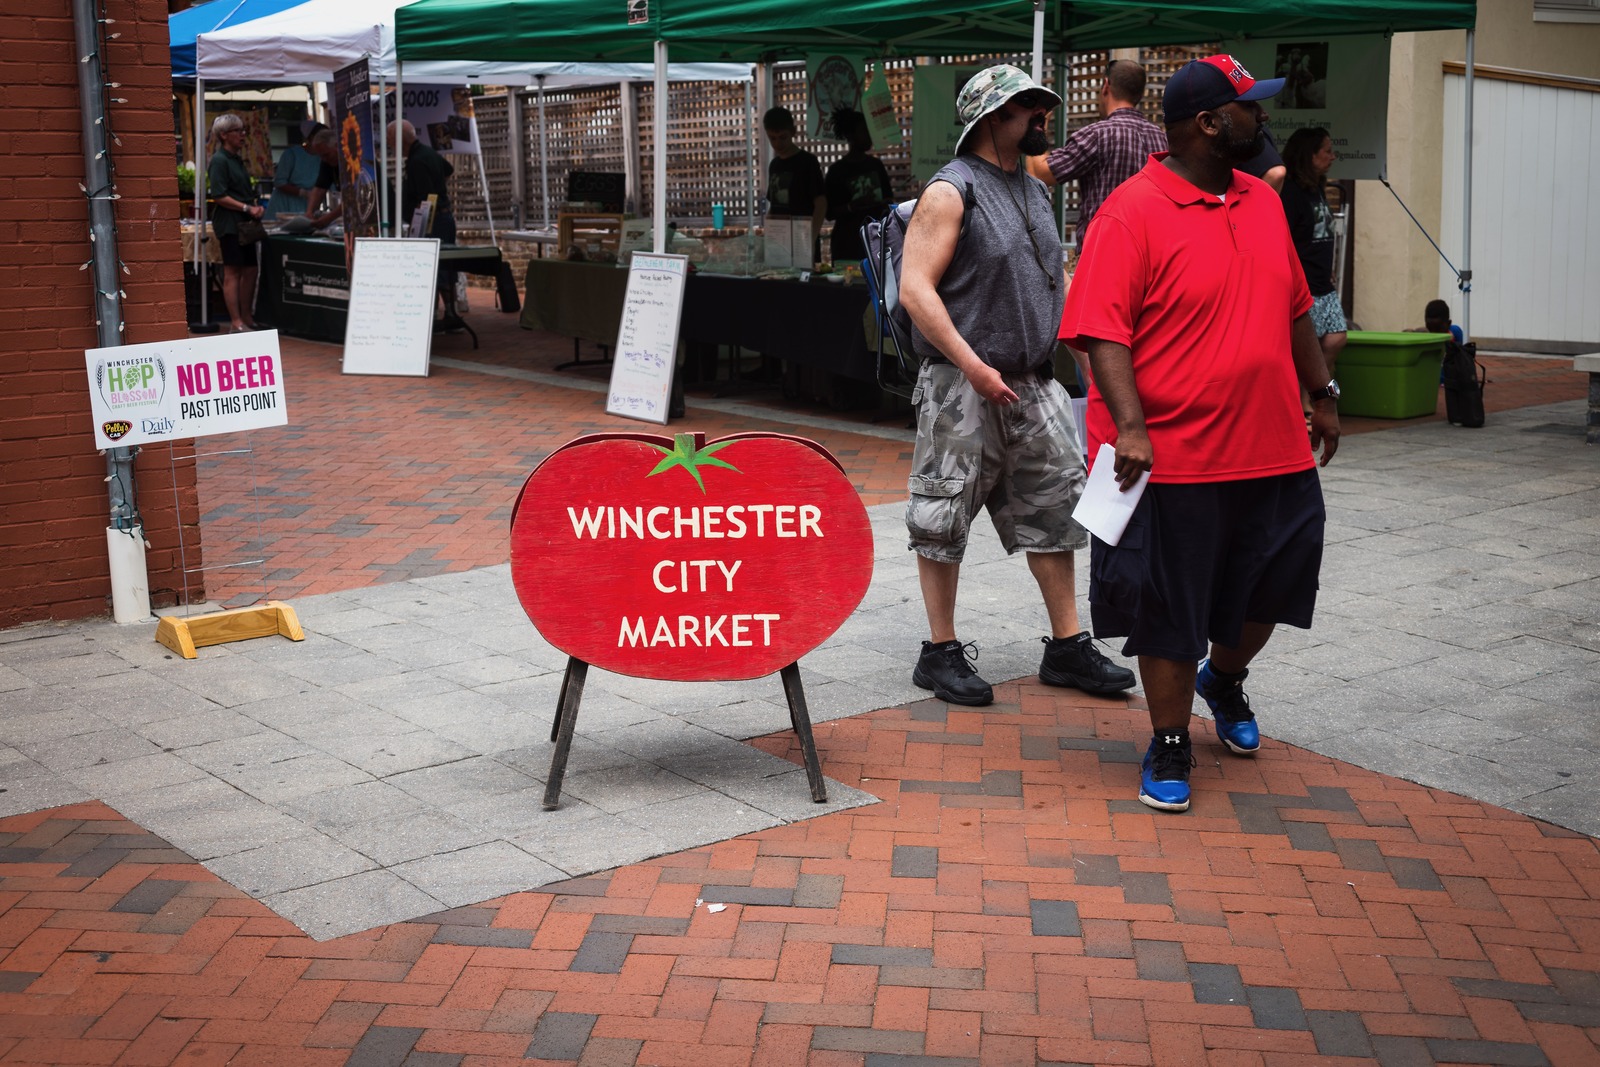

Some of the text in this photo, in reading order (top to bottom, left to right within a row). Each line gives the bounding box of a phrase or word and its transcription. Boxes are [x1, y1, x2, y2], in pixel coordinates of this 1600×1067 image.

[107, 357, 153, 367] WINCHESTER
[176, 355, 275, 397] NO BEER
[108, 364, 154, 392] HOP
[111, 388, 157, 404] BLOSSOM
[181, 391, 276, 420] PAST THIS POINT
[142, 417, 175, 434] Daily
[567, 504, 824, 540] WINCHESTER
[652, 559, 743, 594] CITY
[618, 613, 781, 648] MARKET
